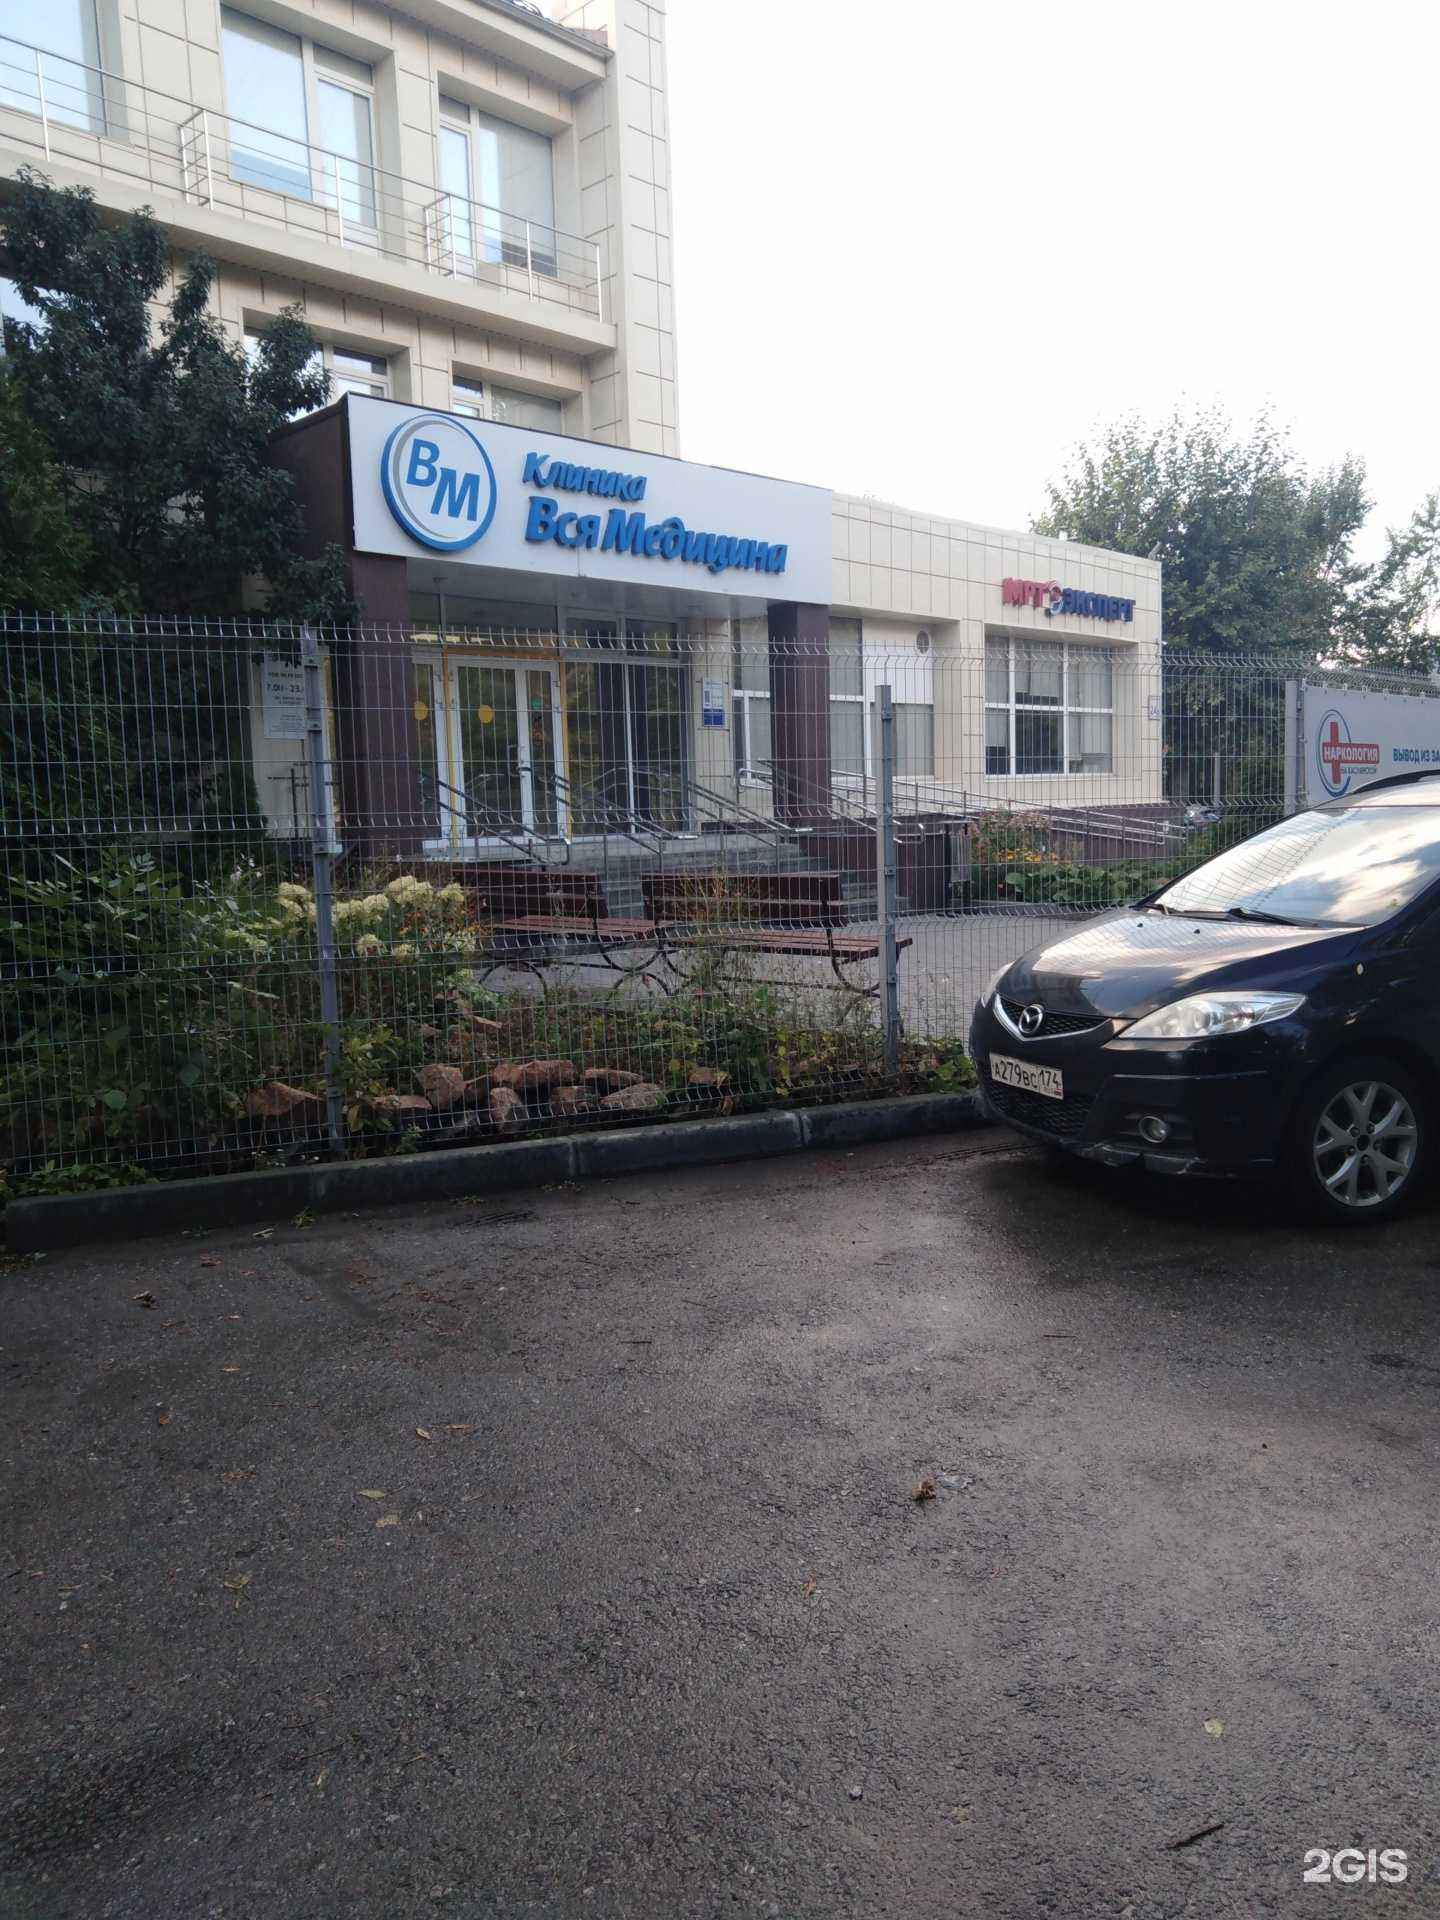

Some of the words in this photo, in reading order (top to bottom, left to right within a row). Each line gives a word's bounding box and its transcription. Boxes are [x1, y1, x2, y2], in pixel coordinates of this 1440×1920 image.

[522, 451, 648, 501] Клиника
[1323, 746, 1378, 762] НАРКОЛОГИЯ
[1393, 748, 1420, 765] ВЫВОД
[1420, 749, 1431, 762] ИЗ
